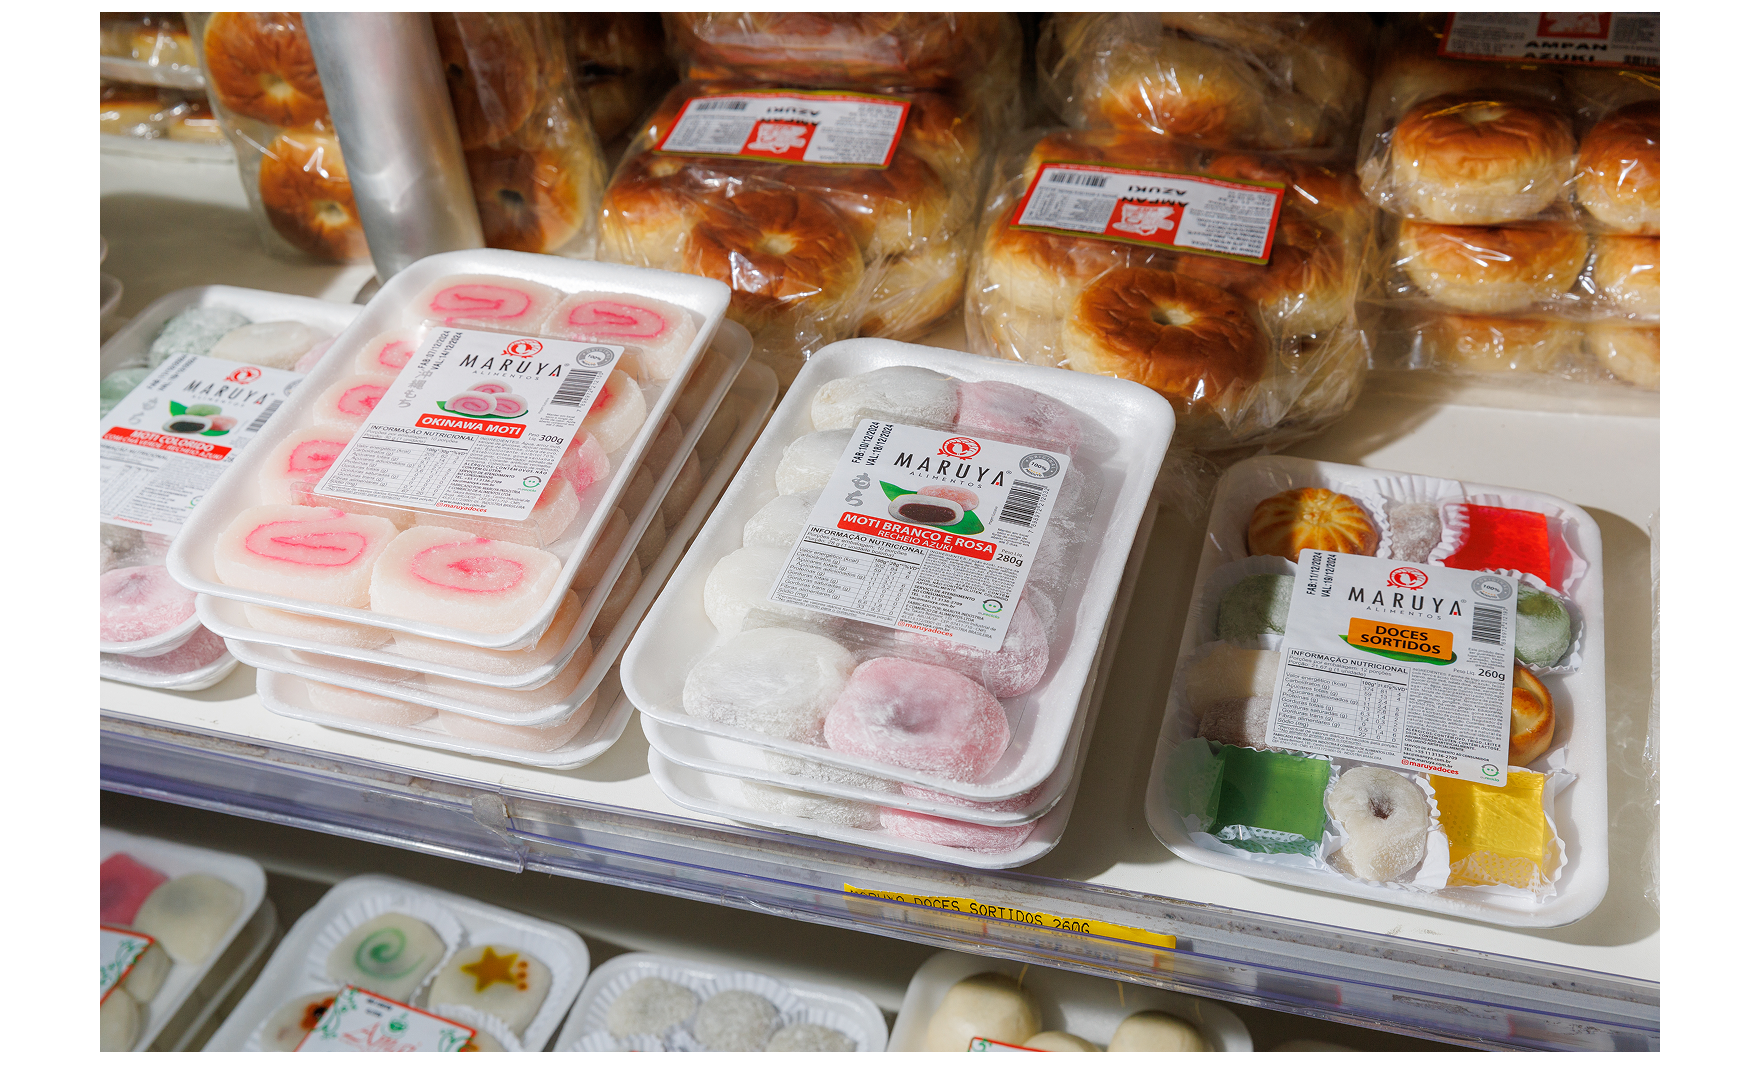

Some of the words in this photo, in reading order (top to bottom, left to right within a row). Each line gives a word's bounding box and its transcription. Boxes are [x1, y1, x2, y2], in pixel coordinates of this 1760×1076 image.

[1525, 40, 1607, 51] AMPAN
[1524, 53, 1594, 63] AZUKI
[767, 106, 820, 117] AZUKI
[1128, 185, 1187, 196] AZUKI
[1121, 196, 1190, 208] AMPAN
[458, 354, 566, 377] MARUYA
[472, 369, 540, 380] ALIMENTOS
[184, 380, 268, 405] MARUYA
[369, 424, 422, 434] INFORMAÇÃO
[422, 431, 475, 441] NUTRICIONAL
[420, 416, 485, 430] OKINAWA
[485, 423, 521, 434] MOTI
[537, 434, 564, 444] 300g
[852, 421, 880, 464] FAB:10/12/2024
[866, 423, 894, 466] VAL:18/12/2024
[893, 451, 1008, 486] MARUYA
[1030, 462, 1048, 470] 100%
[908, 471, 982, 489] ALIMENTOS
[442, 503, 488, 513] maruyadoces
[810, 525, 867, 542] INFORMAÇÃO
[868, 538, 924, 554] NUTRICIONAL
[842, 513, 881, 528] MOTI
[881, 521, 942, 541] BRANCO
[943, 535, 953, 544] E
[954, 537, 994, 553] ROSA
[877, 529, 921, 544] RECHEIO
[921, 539, 953, 551] AZUKI
[995, 553, 1023, 567] 280g
[1306, 551, 1322, 595] FAB:11/12/2024
[1320, 553, 1336, 598] VAL:19/12/2024
[1483, 584, 1499, 592] 100%
[1347, 584, 1462, 617] MARUYA
[1366, 604, 1441, 621] ALIMENTOS
[904, 622, 953, 638] maruyadoces
[1375, 625, 1428, 642] DOCES
[1360, 632, 1440, 655] SORTIDOS
[1291, 649, 1348, 664] INFORMAÇÃO
[1350, 659, 1407, 674] NUTRICIONAL
[1368, 669, 1391, 677] porções
[1478, 667, 1505, 681] 260g
[1409, 760, 1458, 775] maruyadoces
[969, 902, 1043, 926] SORTIDOS
[1053, 918, 1090, 934] 260G
